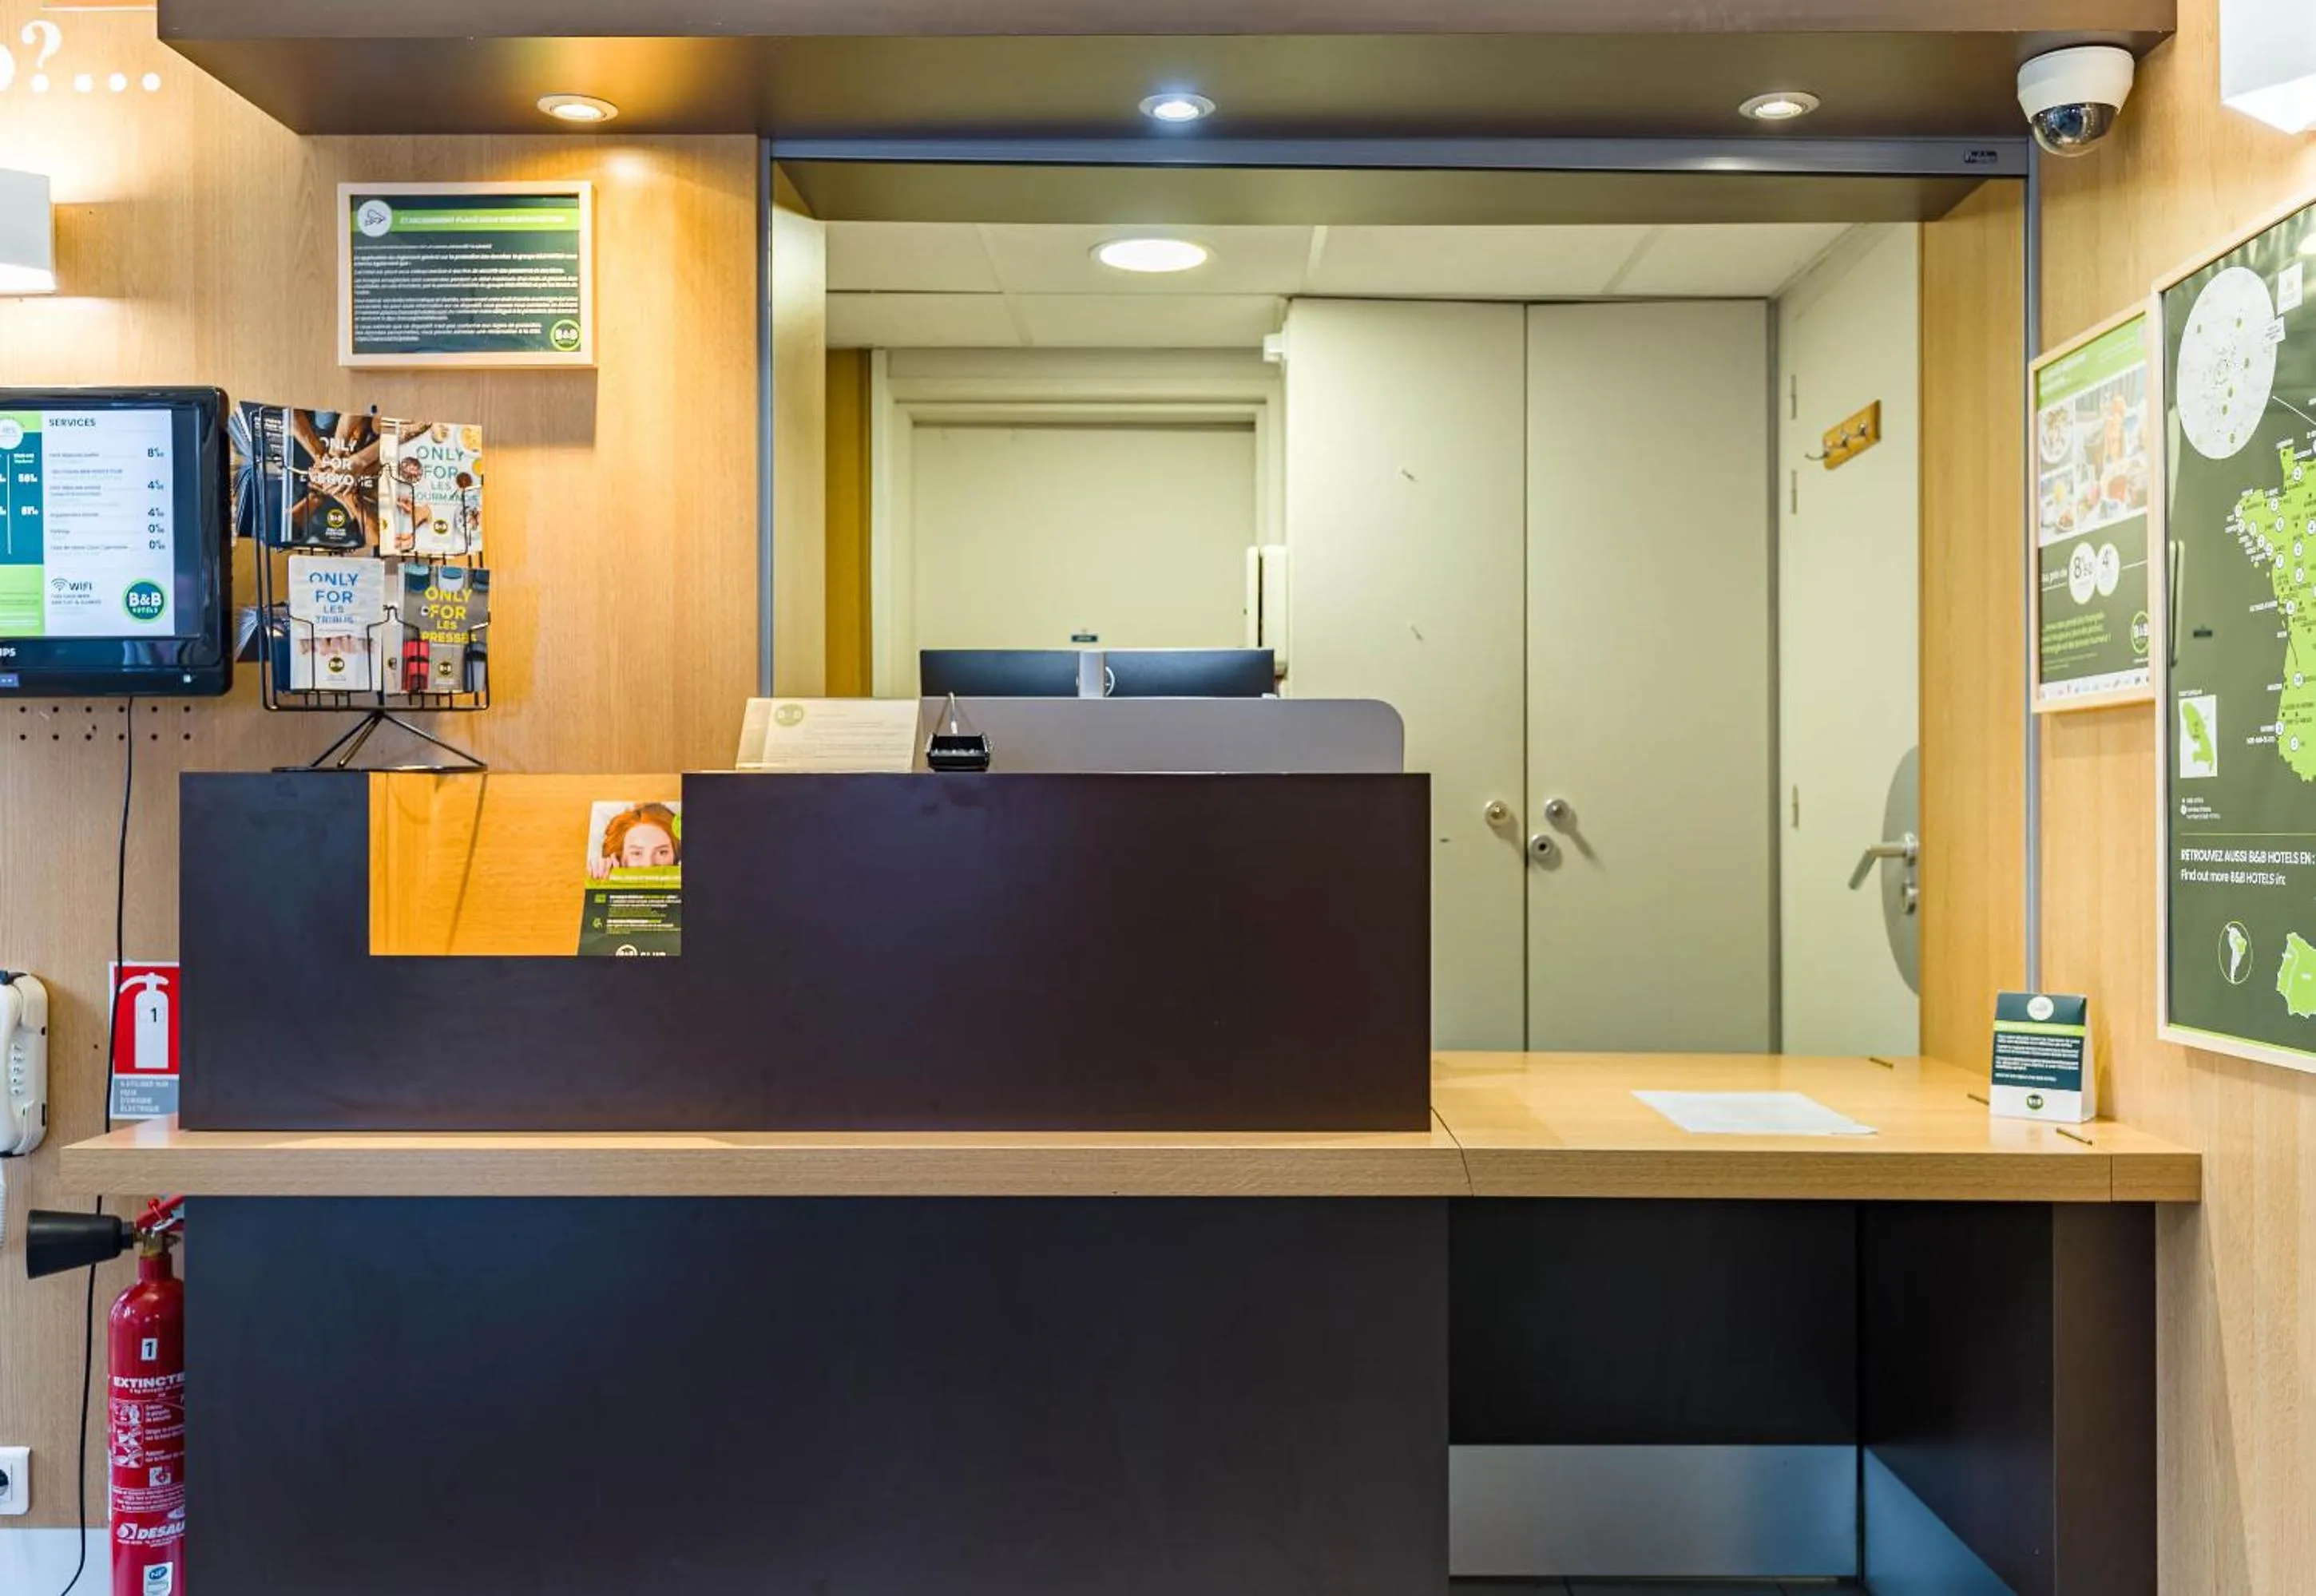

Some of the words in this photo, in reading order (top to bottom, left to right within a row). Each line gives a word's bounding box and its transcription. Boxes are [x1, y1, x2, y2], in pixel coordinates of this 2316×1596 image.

[49, 418, 96, 427] SERVICES
[416, 445, 464, 461] ONLY
[423, 464, 458, 480] FOR
[69, 581, 93, 591] WIFI
[309, 572, 359, 587] ONLY
[129, 592, 161, 607] B&B
[315, 590, 354, 604] FOR
[424, 586, 474, 604] ONLY
[323, 605, 345, 614] LES
[429, 604, 467, 620] FOR
[436, 620, 458, 631] LES
[2180, 849, 2223, 862] RETROUVEZ
[2224, 849, 2247, 863] AUSSI
[2249, 849, 2266, 864] B&B
[2268, 851, 2299, 865] HOTELS
[2180, 868, 2196, 881] Find
[2197, 869, 2209, 881] out
[2210, 872, 2229, 882] more
[2231, 871, 2245, 884] B&B
[2246, 872, 2274, 885] HOTELS
[150, 1007, 157, 1023] 1
[145, 1341, 153, 1357] 1
